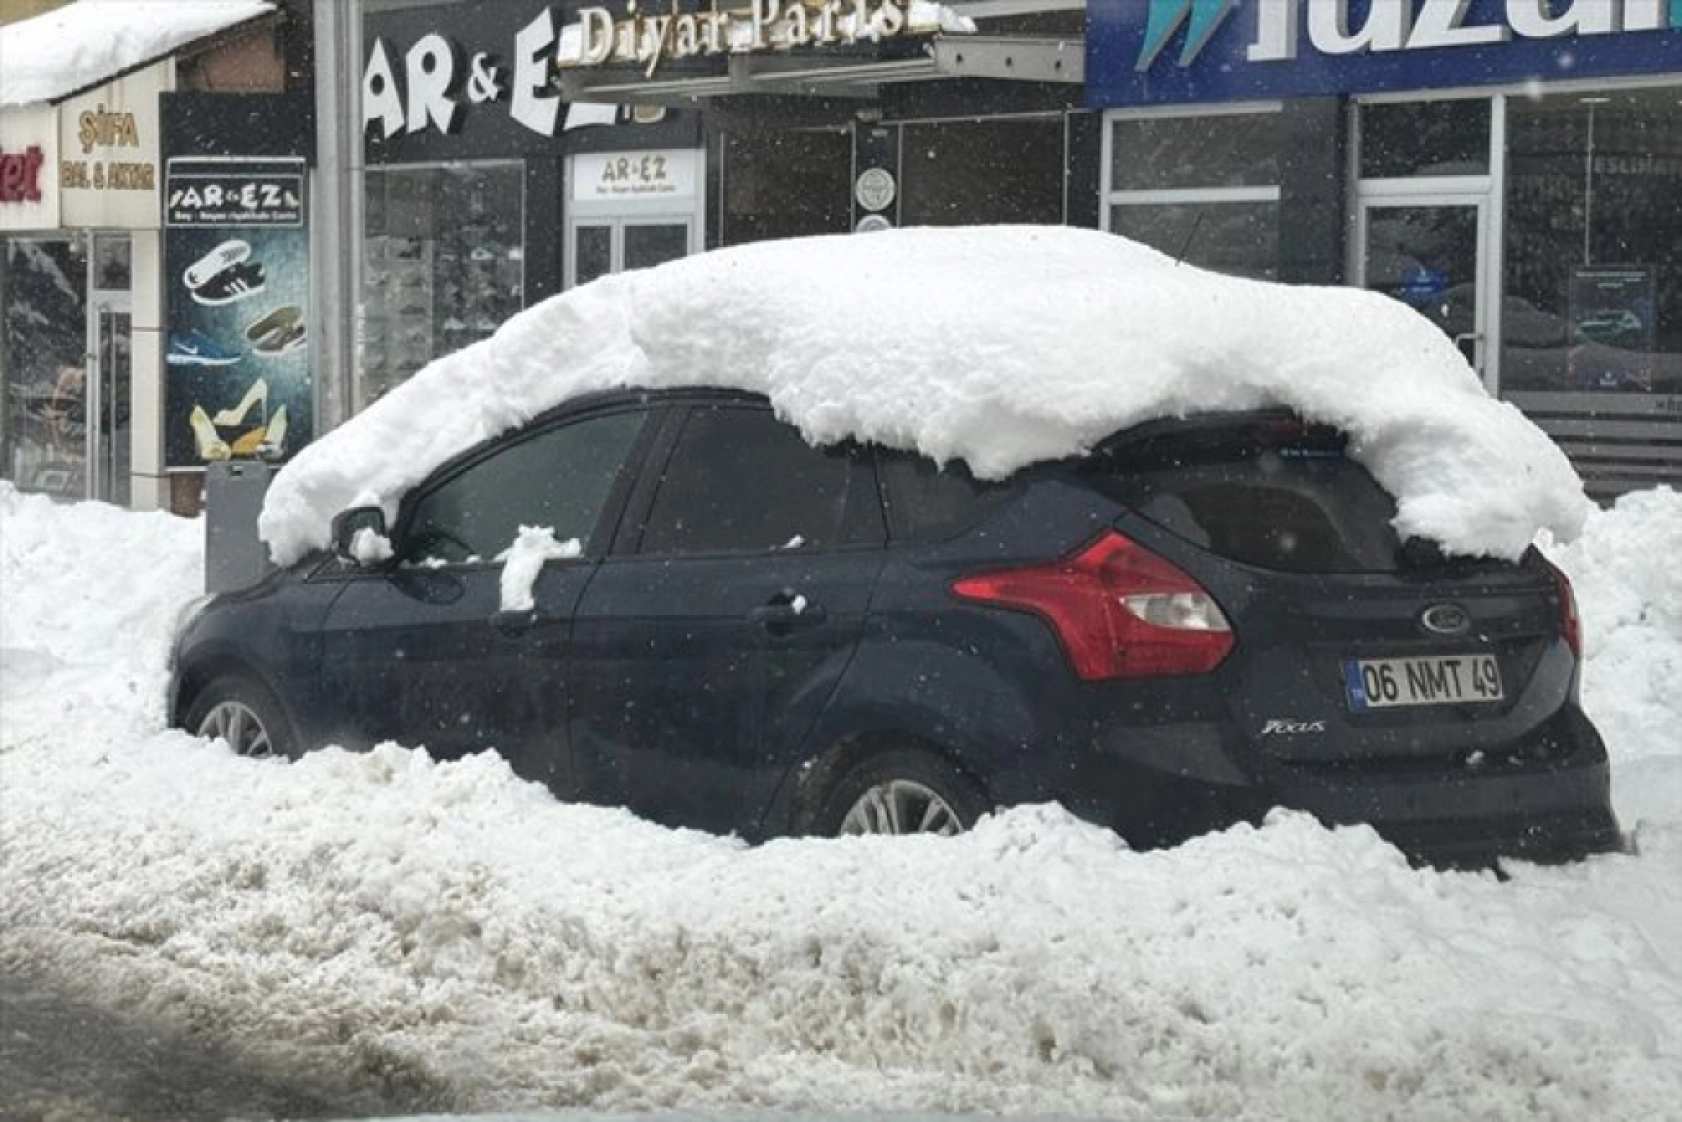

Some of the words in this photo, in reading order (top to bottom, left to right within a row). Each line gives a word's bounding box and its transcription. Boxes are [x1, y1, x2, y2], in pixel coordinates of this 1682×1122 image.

[363, 32, 455, 139] AR
[467, 52, 500, 103] &
[0, 147, 43, 201] et
[602, 155, 627, 182] AR
[641, 154, 667, 182] EZ
[182, 185, 223, 209] AR
[241, 183, 281, 209] EZ
[1363, 664, 1398, 702] 06
[1405, 659, 1461, 699] NMT
[1472, 657, 1499, 698] 49
